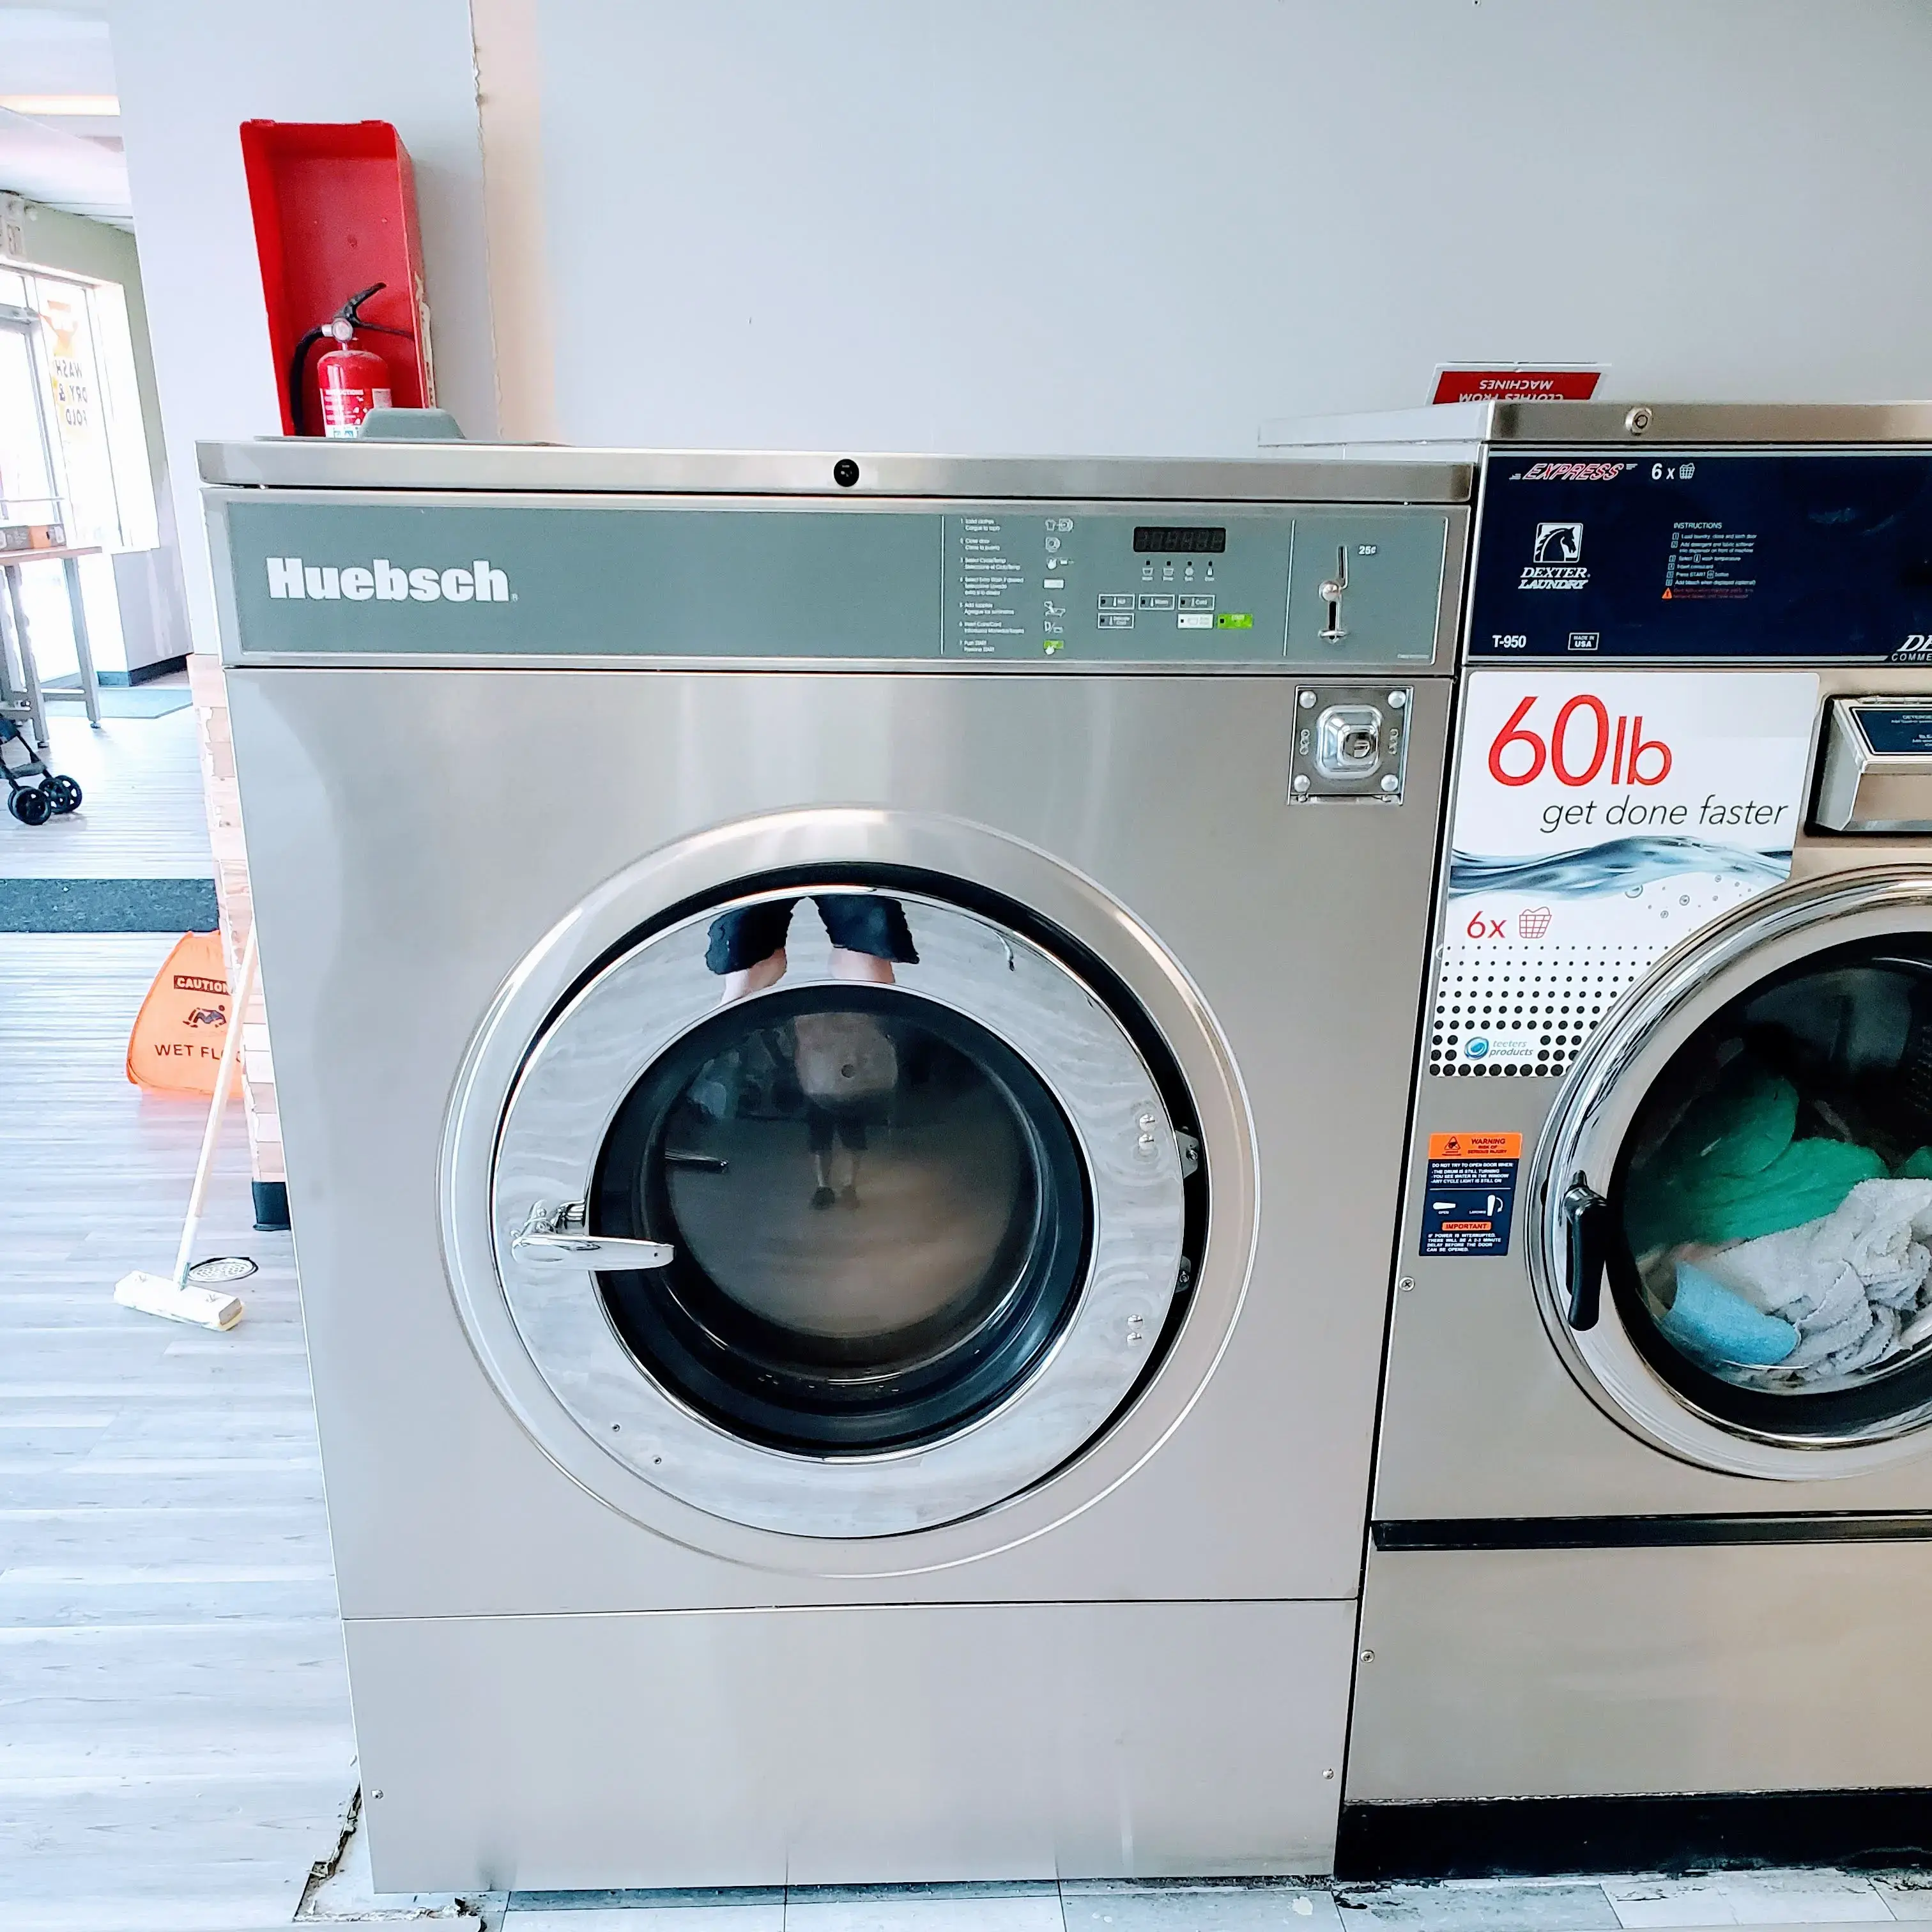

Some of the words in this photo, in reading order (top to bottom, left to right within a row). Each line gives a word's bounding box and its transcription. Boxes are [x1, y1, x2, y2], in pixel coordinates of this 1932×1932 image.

[1479, 380, 1554, 390] MACHINES
[1522, 463, 1623, 480] EXPRESS
[1652, 463, 1662, 479] 6
[266, 557, 510, 602] Huebsch
[1520, 567, 1588, 578] DEXTER
[1517, 579, 1588, 589] LAUNDRY
[1492, 634, 1527, 648] T-950
[1488, 694, 1673, 786] 60lb
[1540, 799, 1597, 834] get
[1605, 795, 1687, 825] done
[1698, 793, 1789, 825] faster
[1466, 910, 1506, 939] 6x
[176, 977, 231, 995] CAUTION
[155, 1045, 194, 1056] WET
[1489, 1048, 1534, 1058] products
